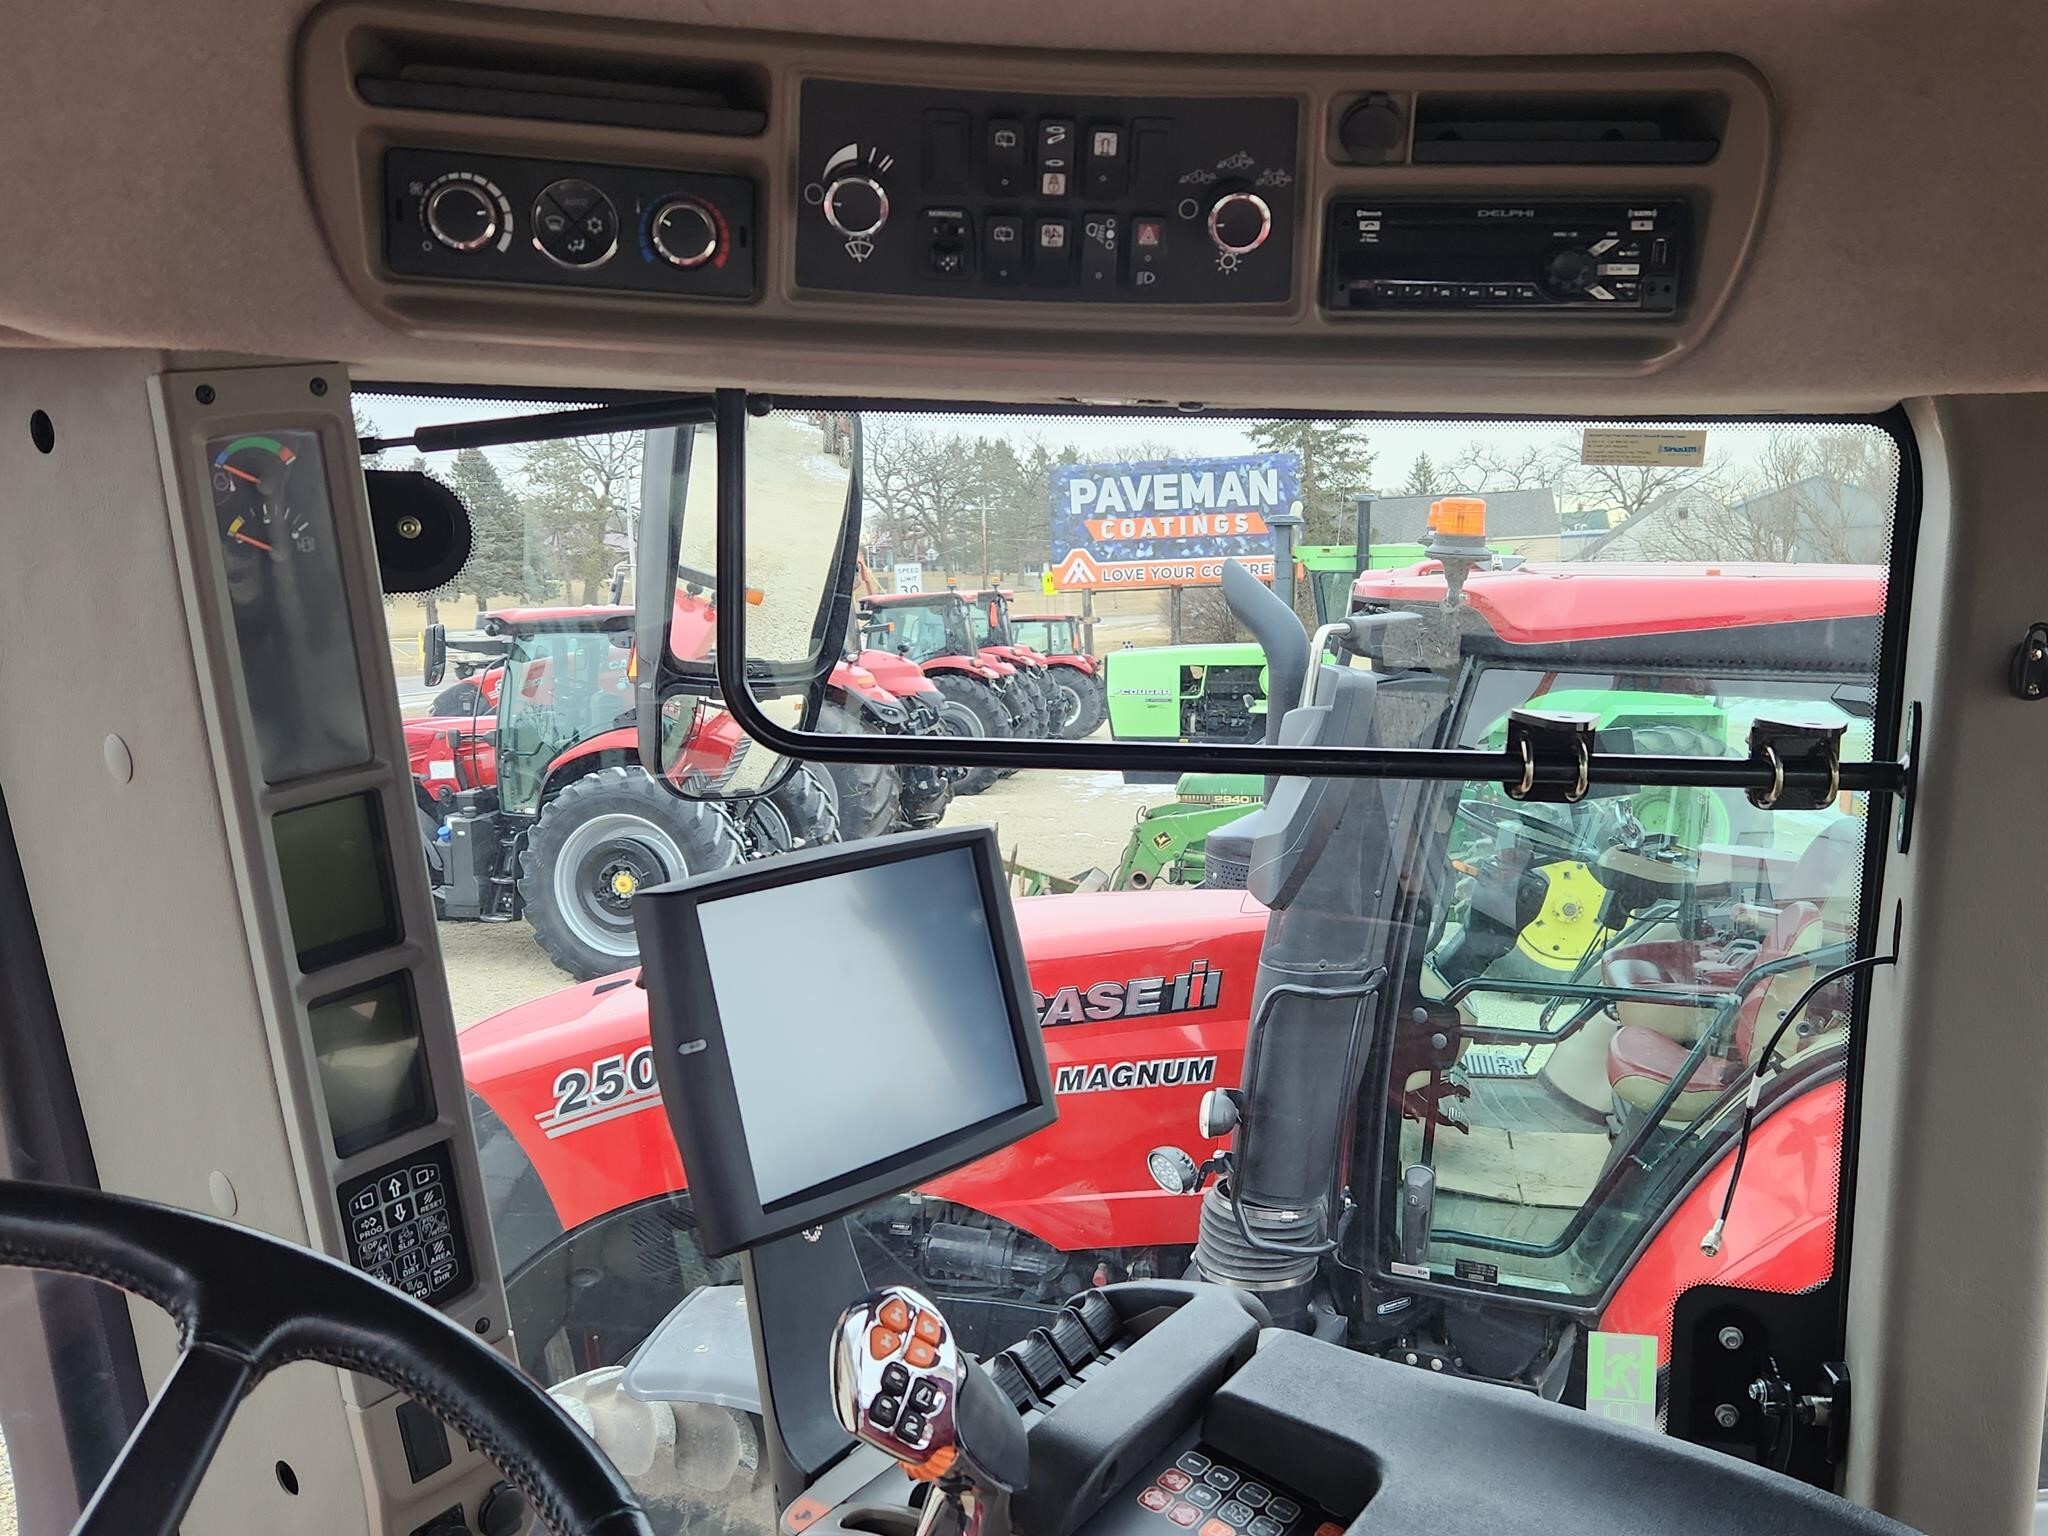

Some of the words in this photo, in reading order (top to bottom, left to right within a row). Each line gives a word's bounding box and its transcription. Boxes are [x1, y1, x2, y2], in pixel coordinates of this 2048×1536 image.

[1477, 209, 1534, 217] DELPHI
[1069, 469, 1279, 515] PAVEMAN
[1100, 513, 1249, 539] COATINGS
[1102, 567, 1144, 582] LOVE
[1149, 565, 1195, 580] YOUR
[1201, 562, 1275, 577] CORE
[900, 575, 917, 583] LIMIT
[1214, 795, 1250, 804] 2940
[1056, 1057, 1216, 1093] MAGNUM
[554, 1047, 658, 1117] 250
[420, 1199, 443, 1213] RESET
[359, 1225, 383, 1240] PROG
[398, 1238, 415, 1251] SLIP
[430, 1250, 451, 1264] AREA
[402, 1264, 420, 1277] DIST
[1187, 1458, 1202, 1467] 1
[1214, 1472, 1229, 1483] 3
[1196, 1489, 1212, 1501] 5
